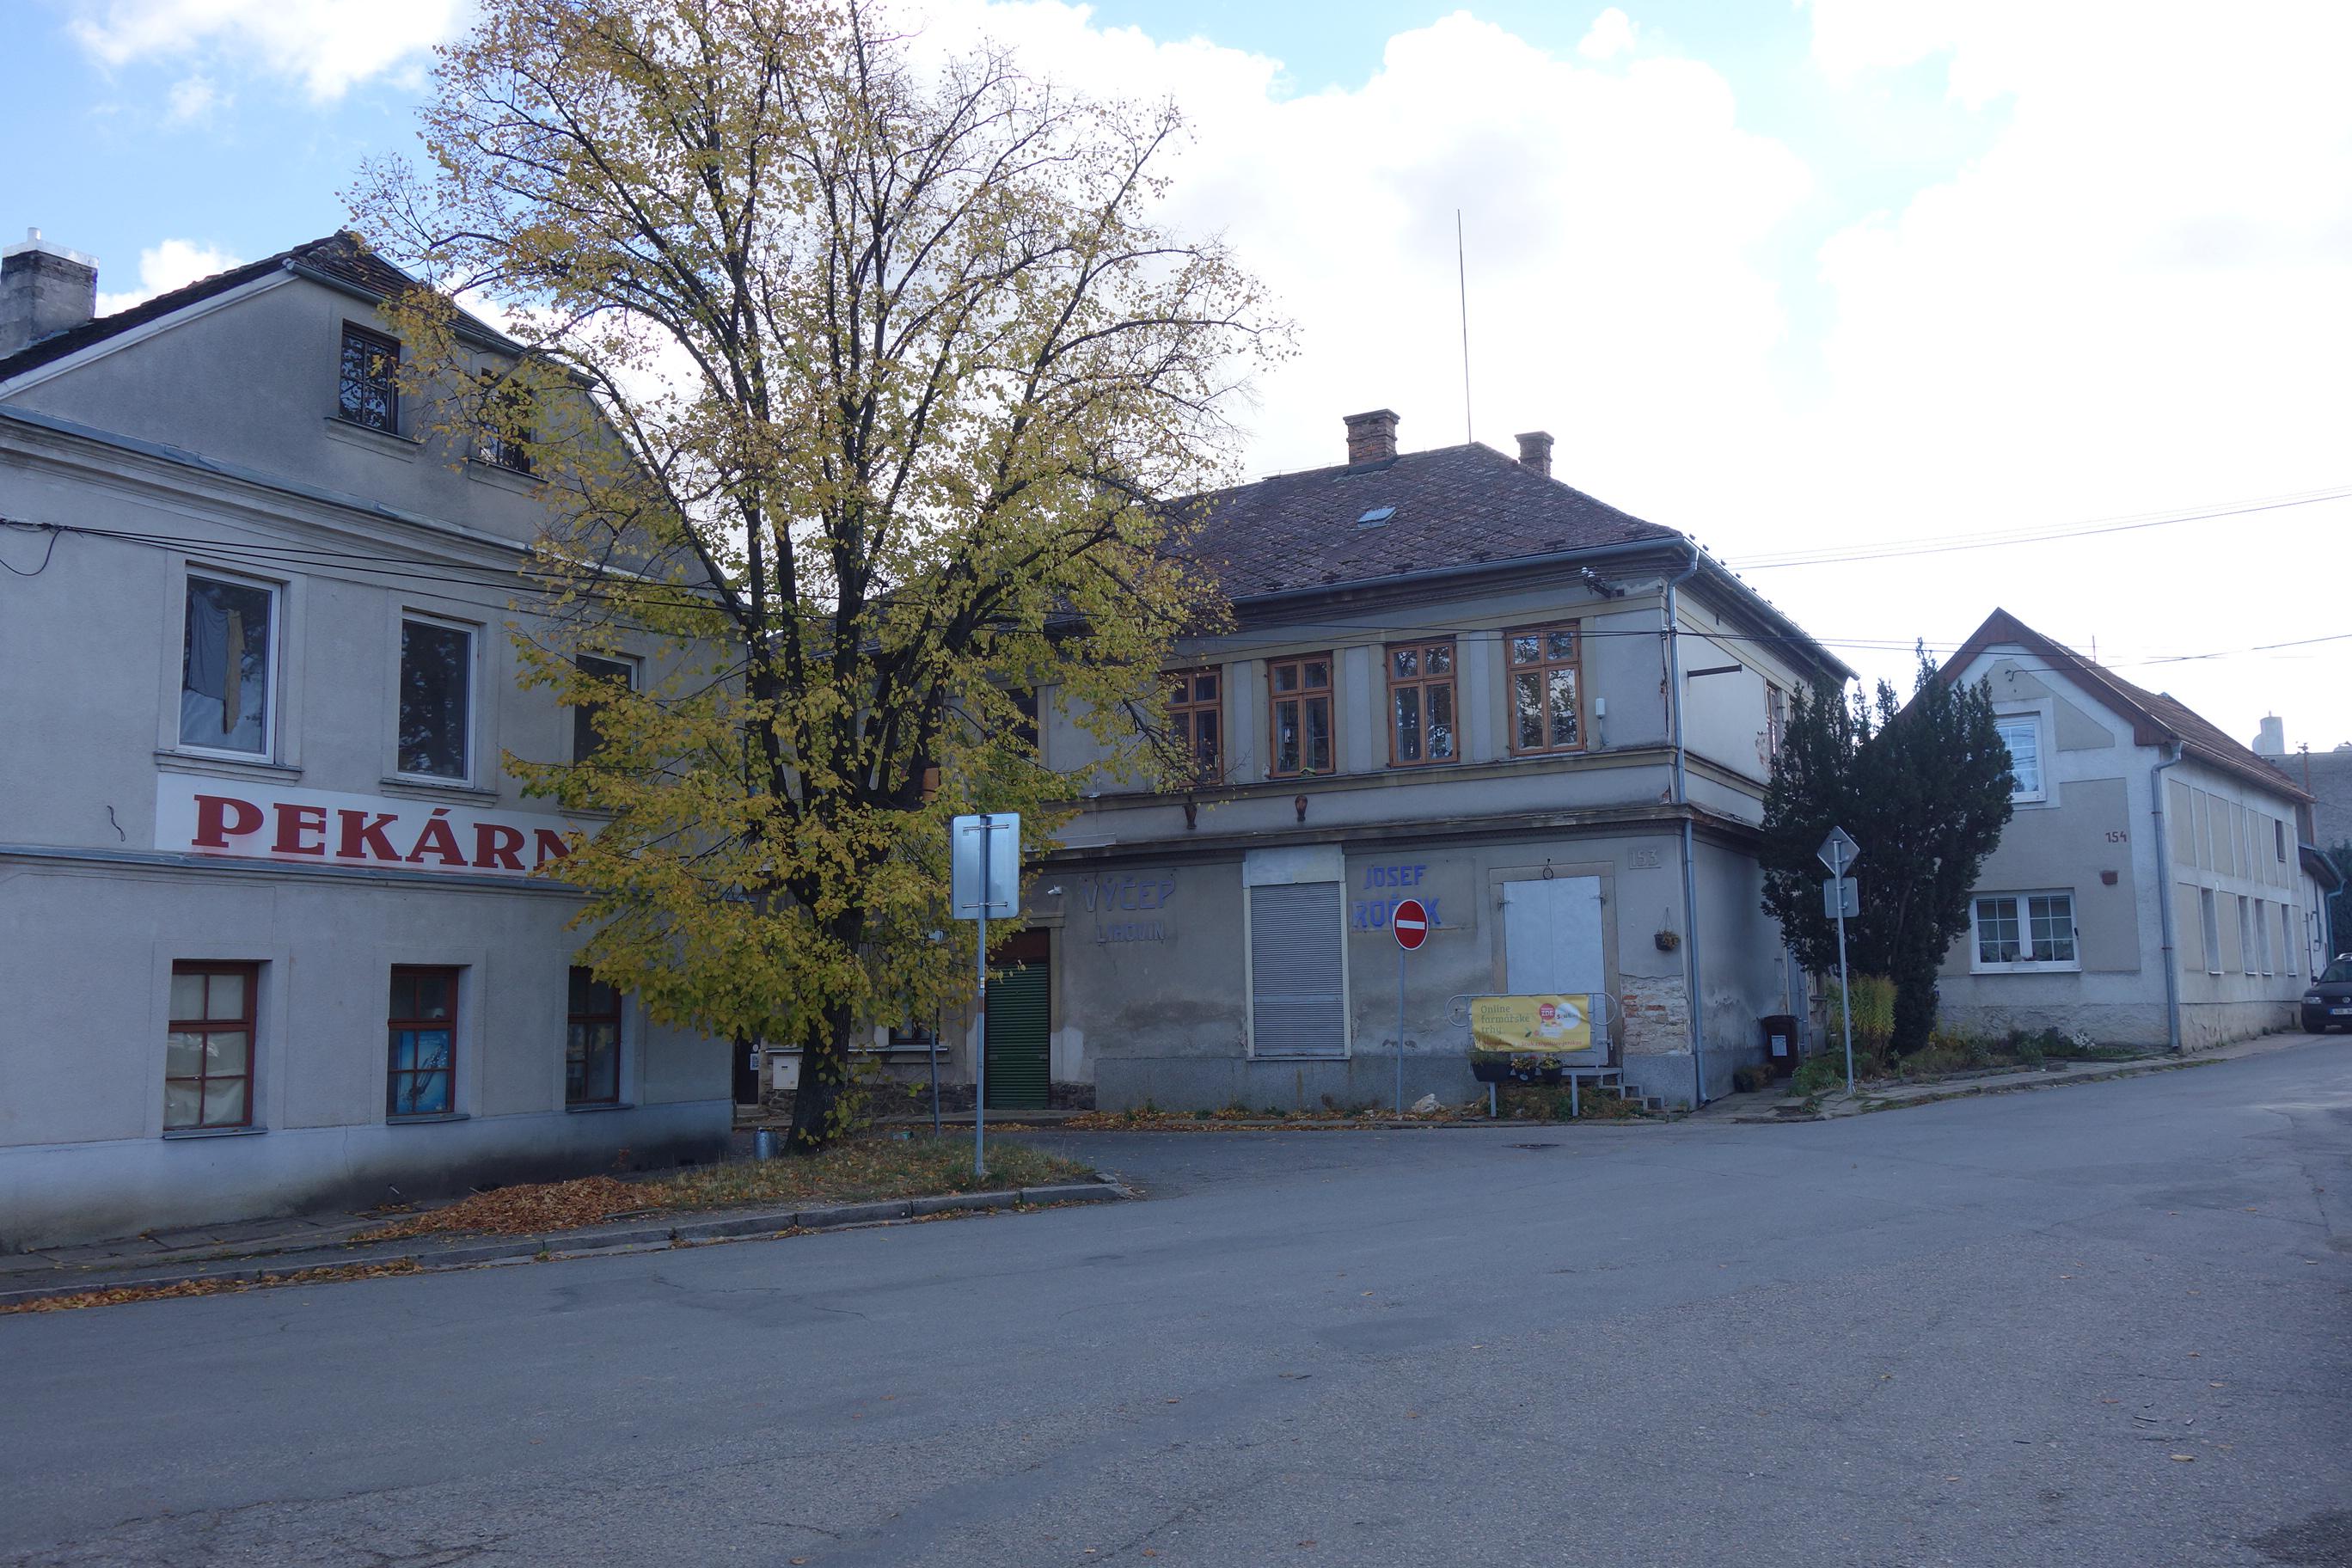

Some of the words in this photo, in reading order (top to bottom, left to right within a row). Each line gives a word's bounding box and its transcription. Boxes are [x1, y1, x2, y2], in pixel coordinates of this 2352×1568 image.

[192, 794, 588, 872] PEKÁRN
[2105, 830, 2127, 842] 154
[1629, 849, 1658, 867] 153
[1363, 865, 1427, 889] JOSEF
[1081, 877, 1176, 912] VÝČEP
[1351, 894, 1442, 928] ROČK
[1480, 1004, 1511, 1014] Online
[1481, 1025, 1502, 1034] trhy
